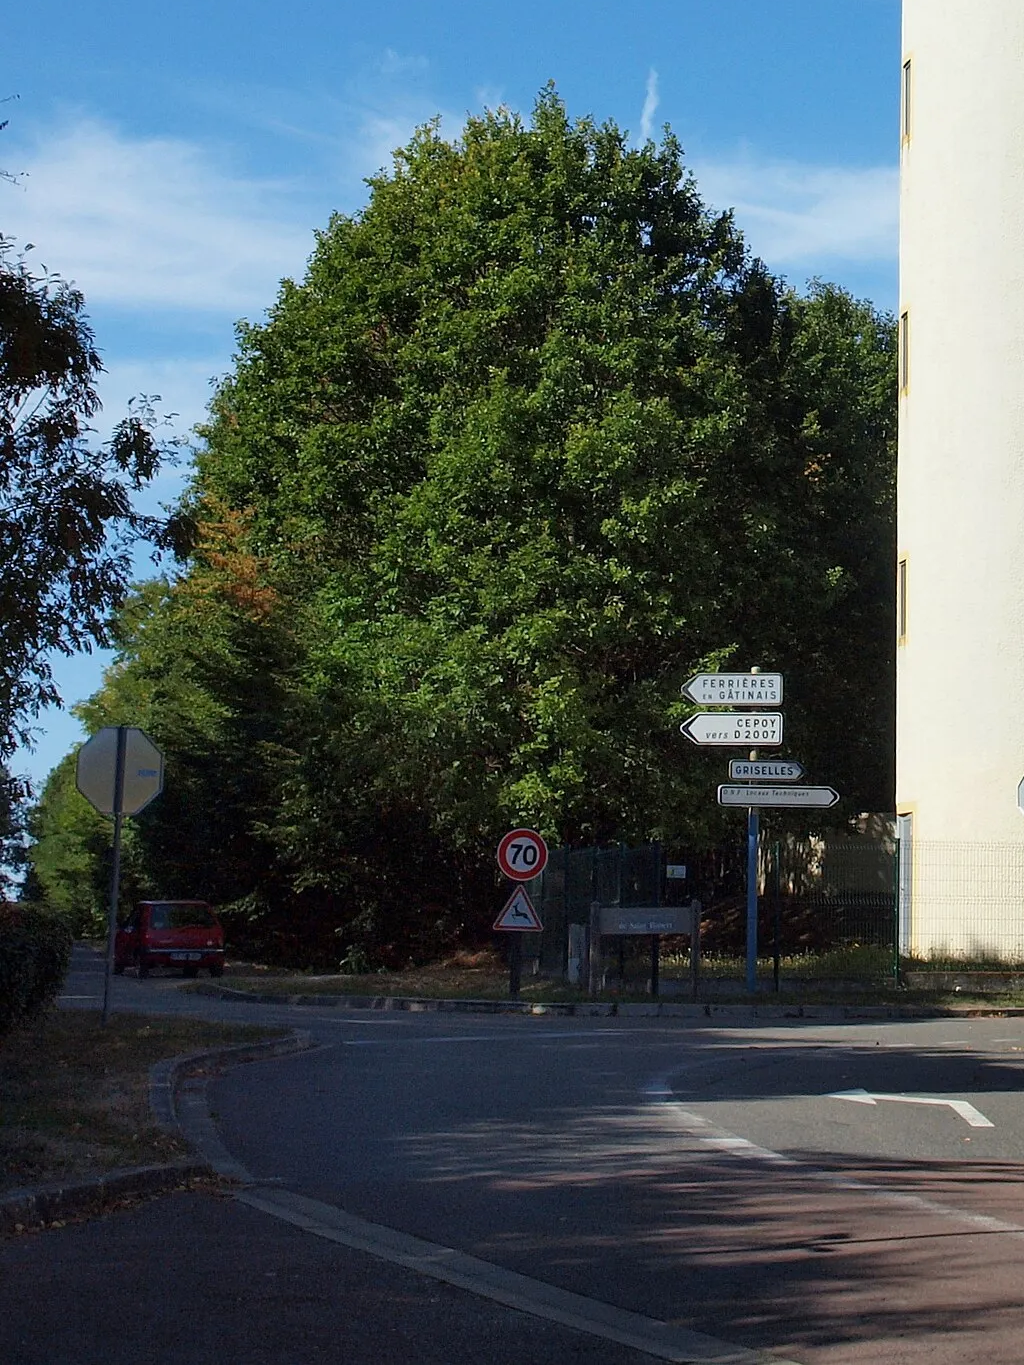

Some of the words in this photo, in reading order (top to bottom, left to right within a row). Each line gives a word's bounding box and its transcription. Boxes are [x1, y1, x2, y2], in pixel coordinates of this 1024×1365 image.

[703, 678, 774, 688] FERRIÈRES
[719, 689, 777, 700] GÂTINAIS
[736, 719, 776, 728] CEPOY
[735, 766, 794, 775] GRISELLES
[510, 843, 538, 866] 70
